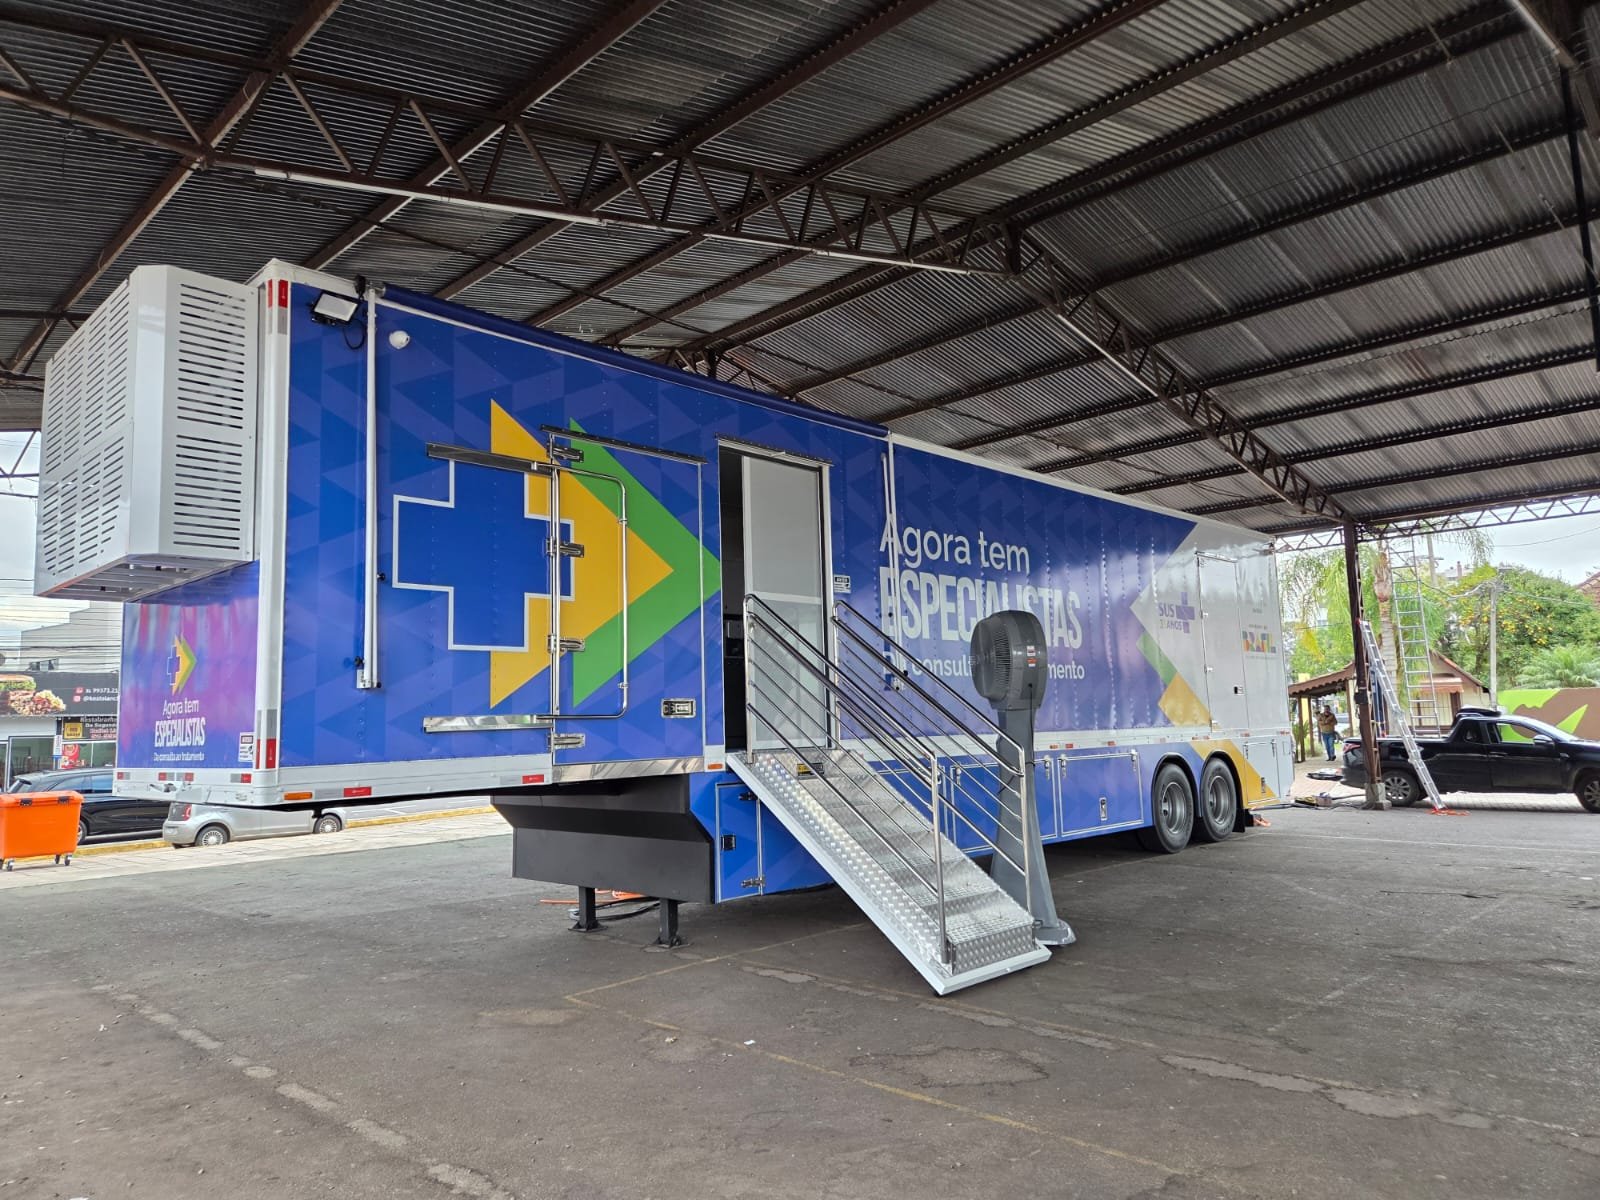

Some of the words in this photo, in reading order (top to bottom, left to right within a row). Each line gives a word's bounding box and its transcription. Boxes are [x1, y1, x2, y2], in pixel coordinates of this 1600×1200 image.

[879, 517, 972, 568] Agora
[978, 531, 1030, 576] tem
[1158, 603, 1175, 618] SUS
[162, 699, 183, 720] Agora
[184, 697, 199, 713] tem
[154, 716, 206, 748] ESPECIALISTAS
